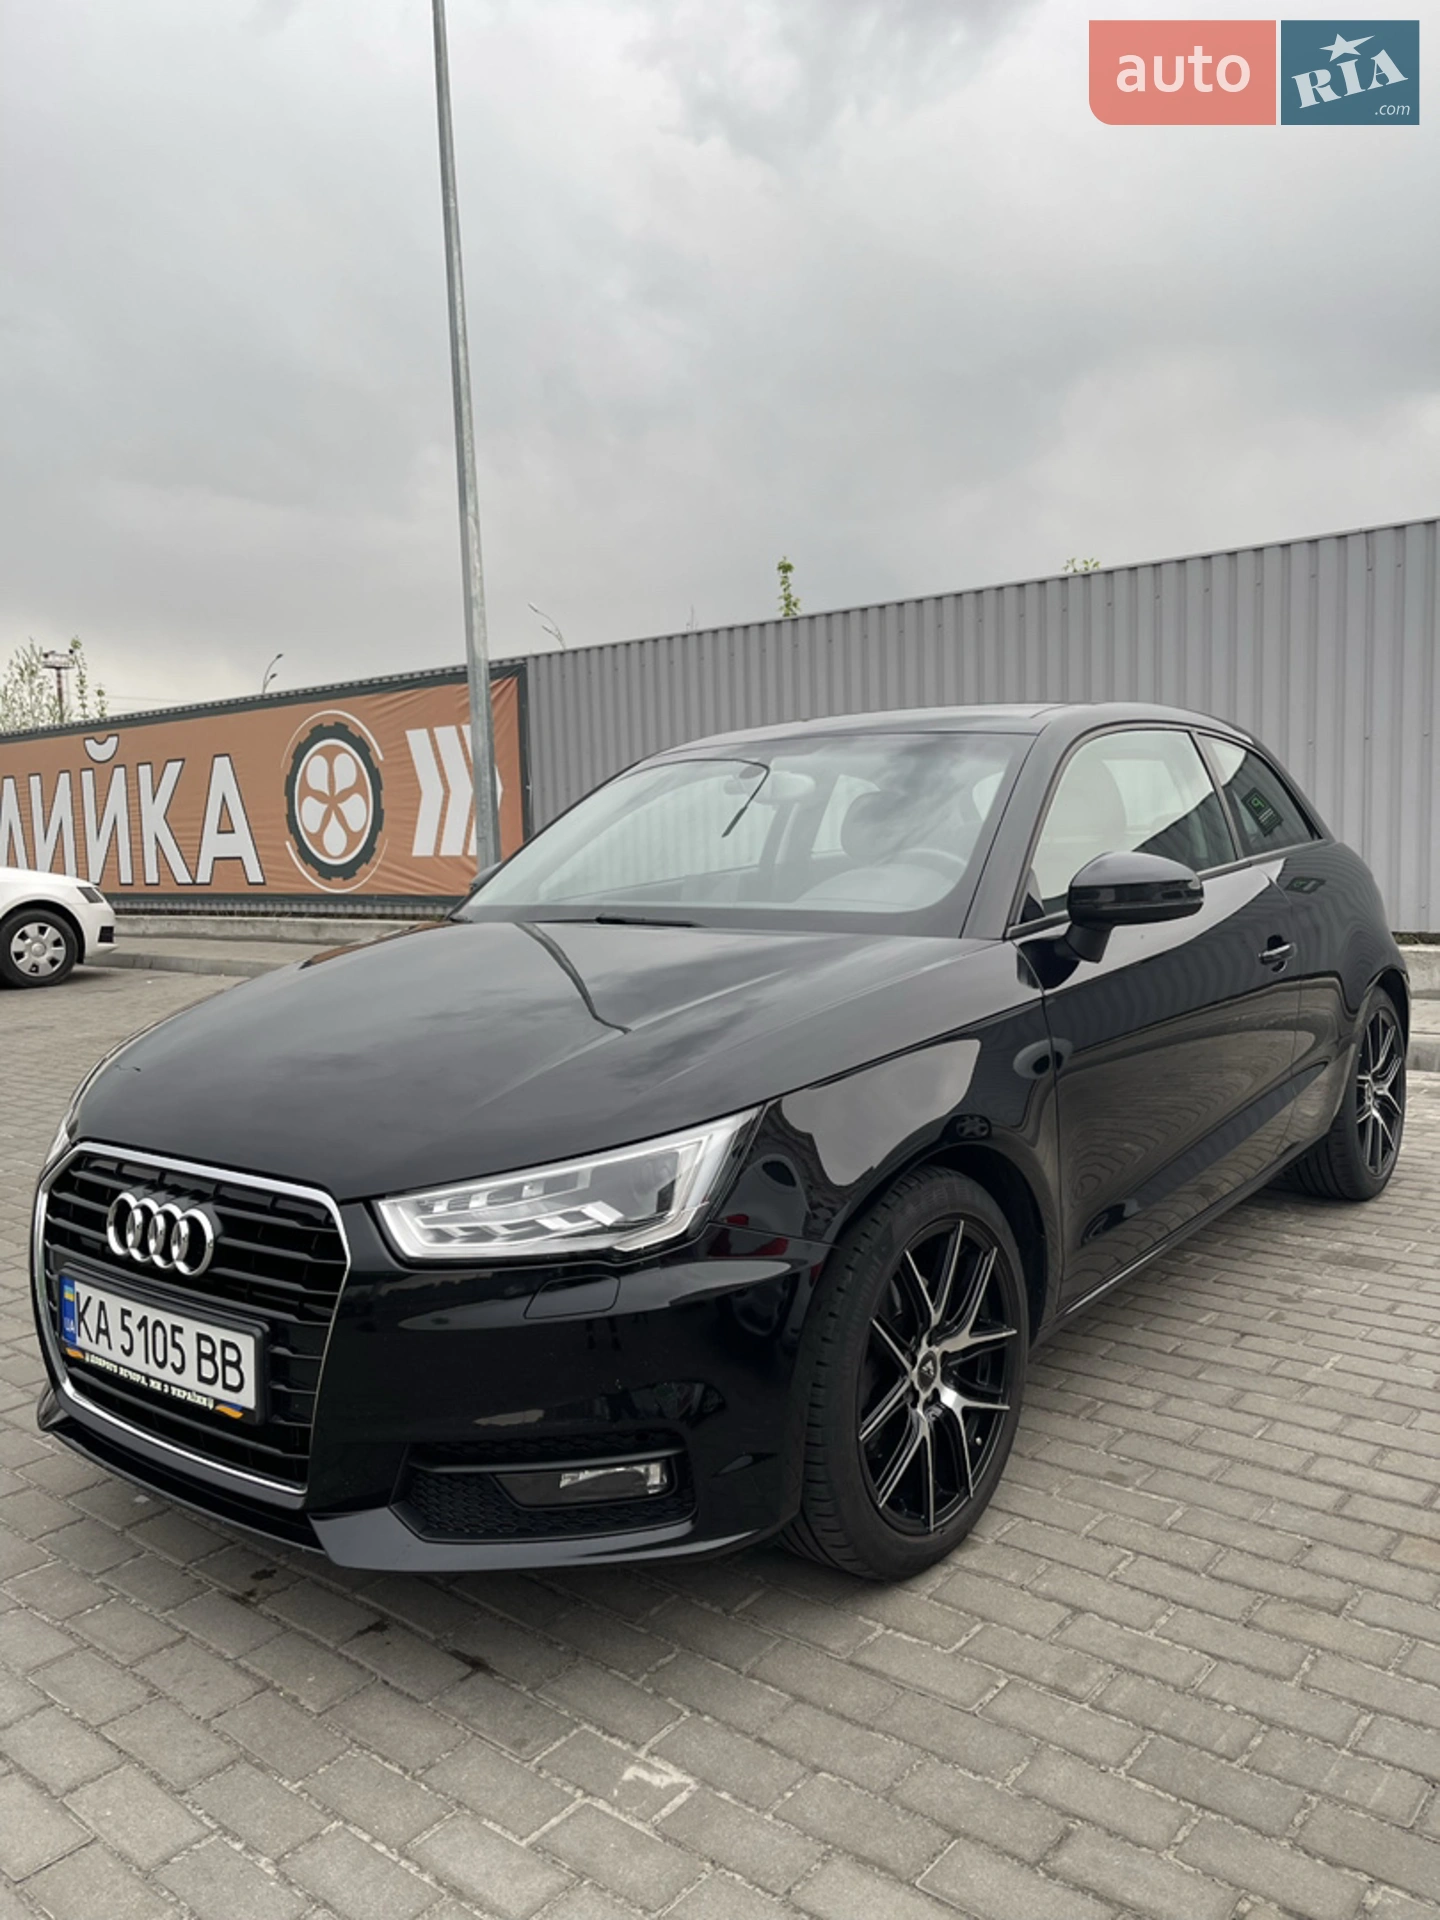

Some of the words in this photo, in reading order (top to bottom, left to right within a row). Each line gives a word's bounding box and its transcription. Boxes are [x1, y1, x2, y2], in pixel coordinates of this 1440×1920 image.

[76, 1291, 113, 1351] KA
[120, 1307, 186, 1375] 5105
[196, 1331, 245, 1394] BB
